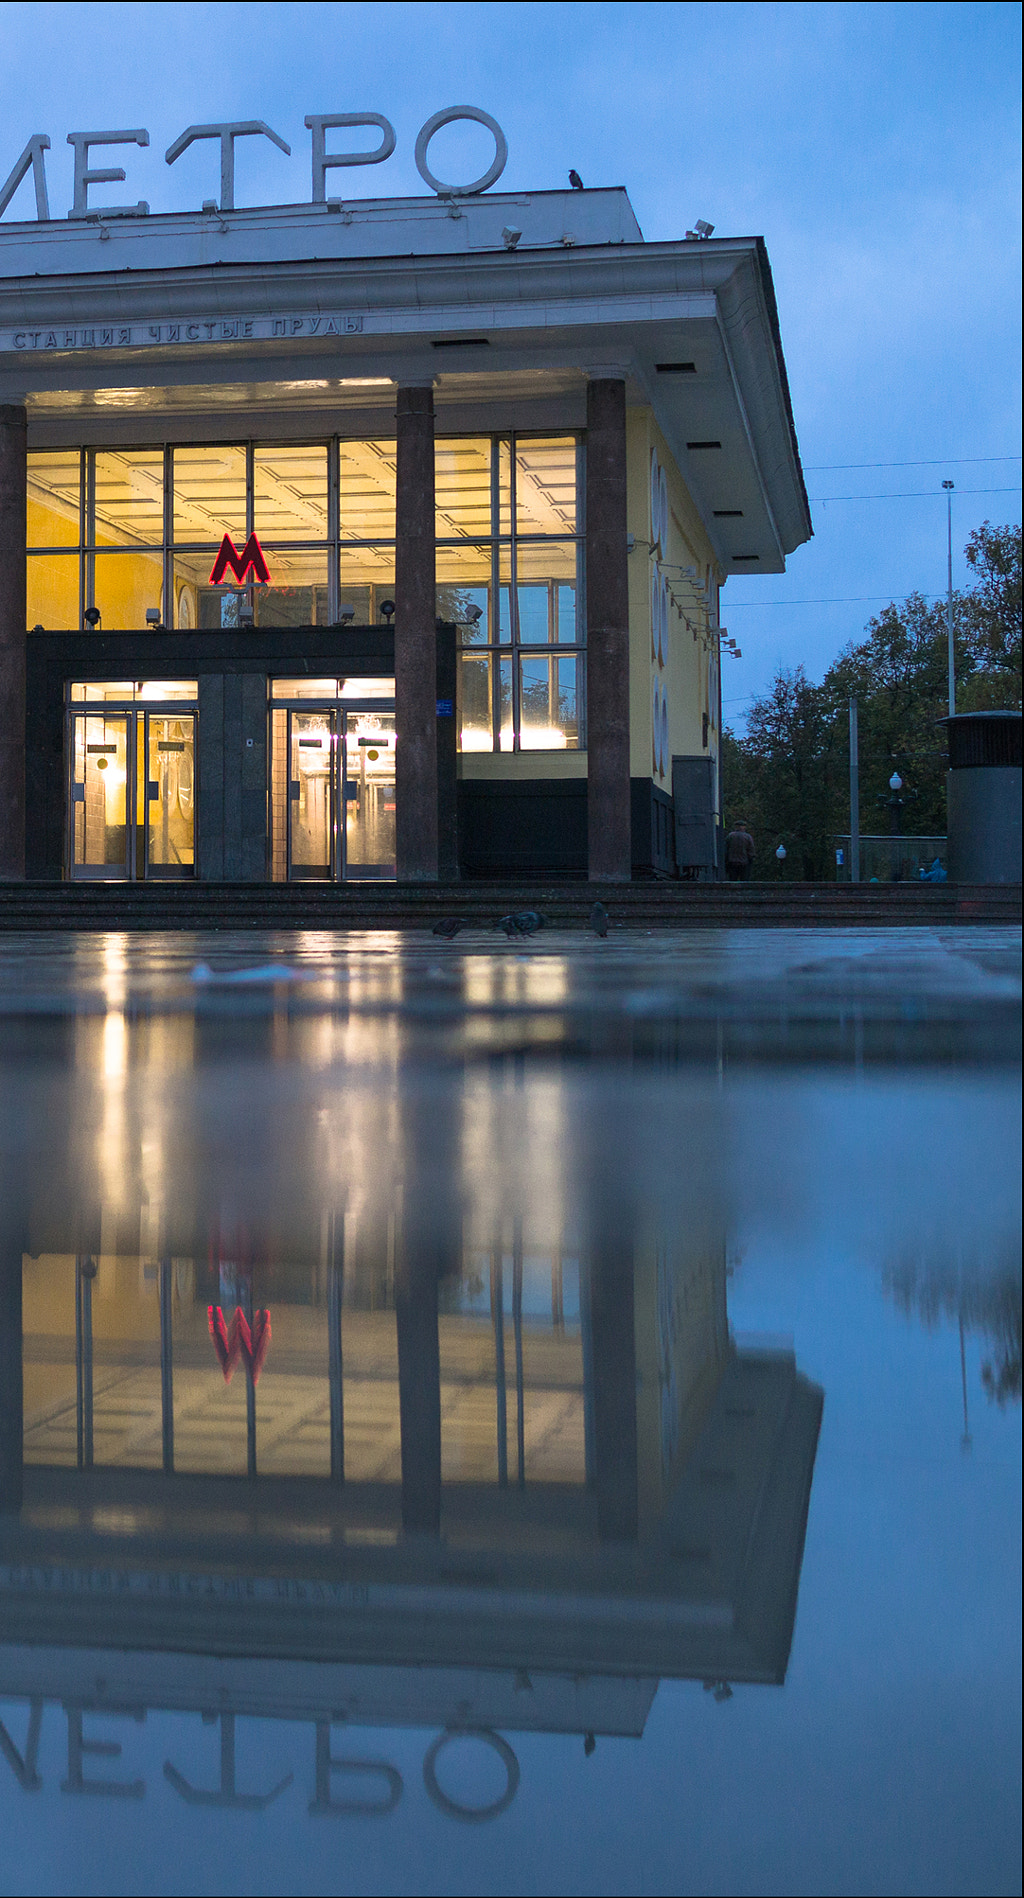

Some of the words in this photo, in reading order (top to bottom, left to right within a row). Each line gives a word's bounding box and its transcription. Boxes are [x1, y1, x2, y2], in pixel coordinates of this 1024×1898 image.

[13, 326, 132, 350] СТАНЦИЯ
[149, 320, 254, 343] ЧИСТЫЕ
[272, 315, 364, 337] ПРУДЫ
[209, 532, 271, 585] М
